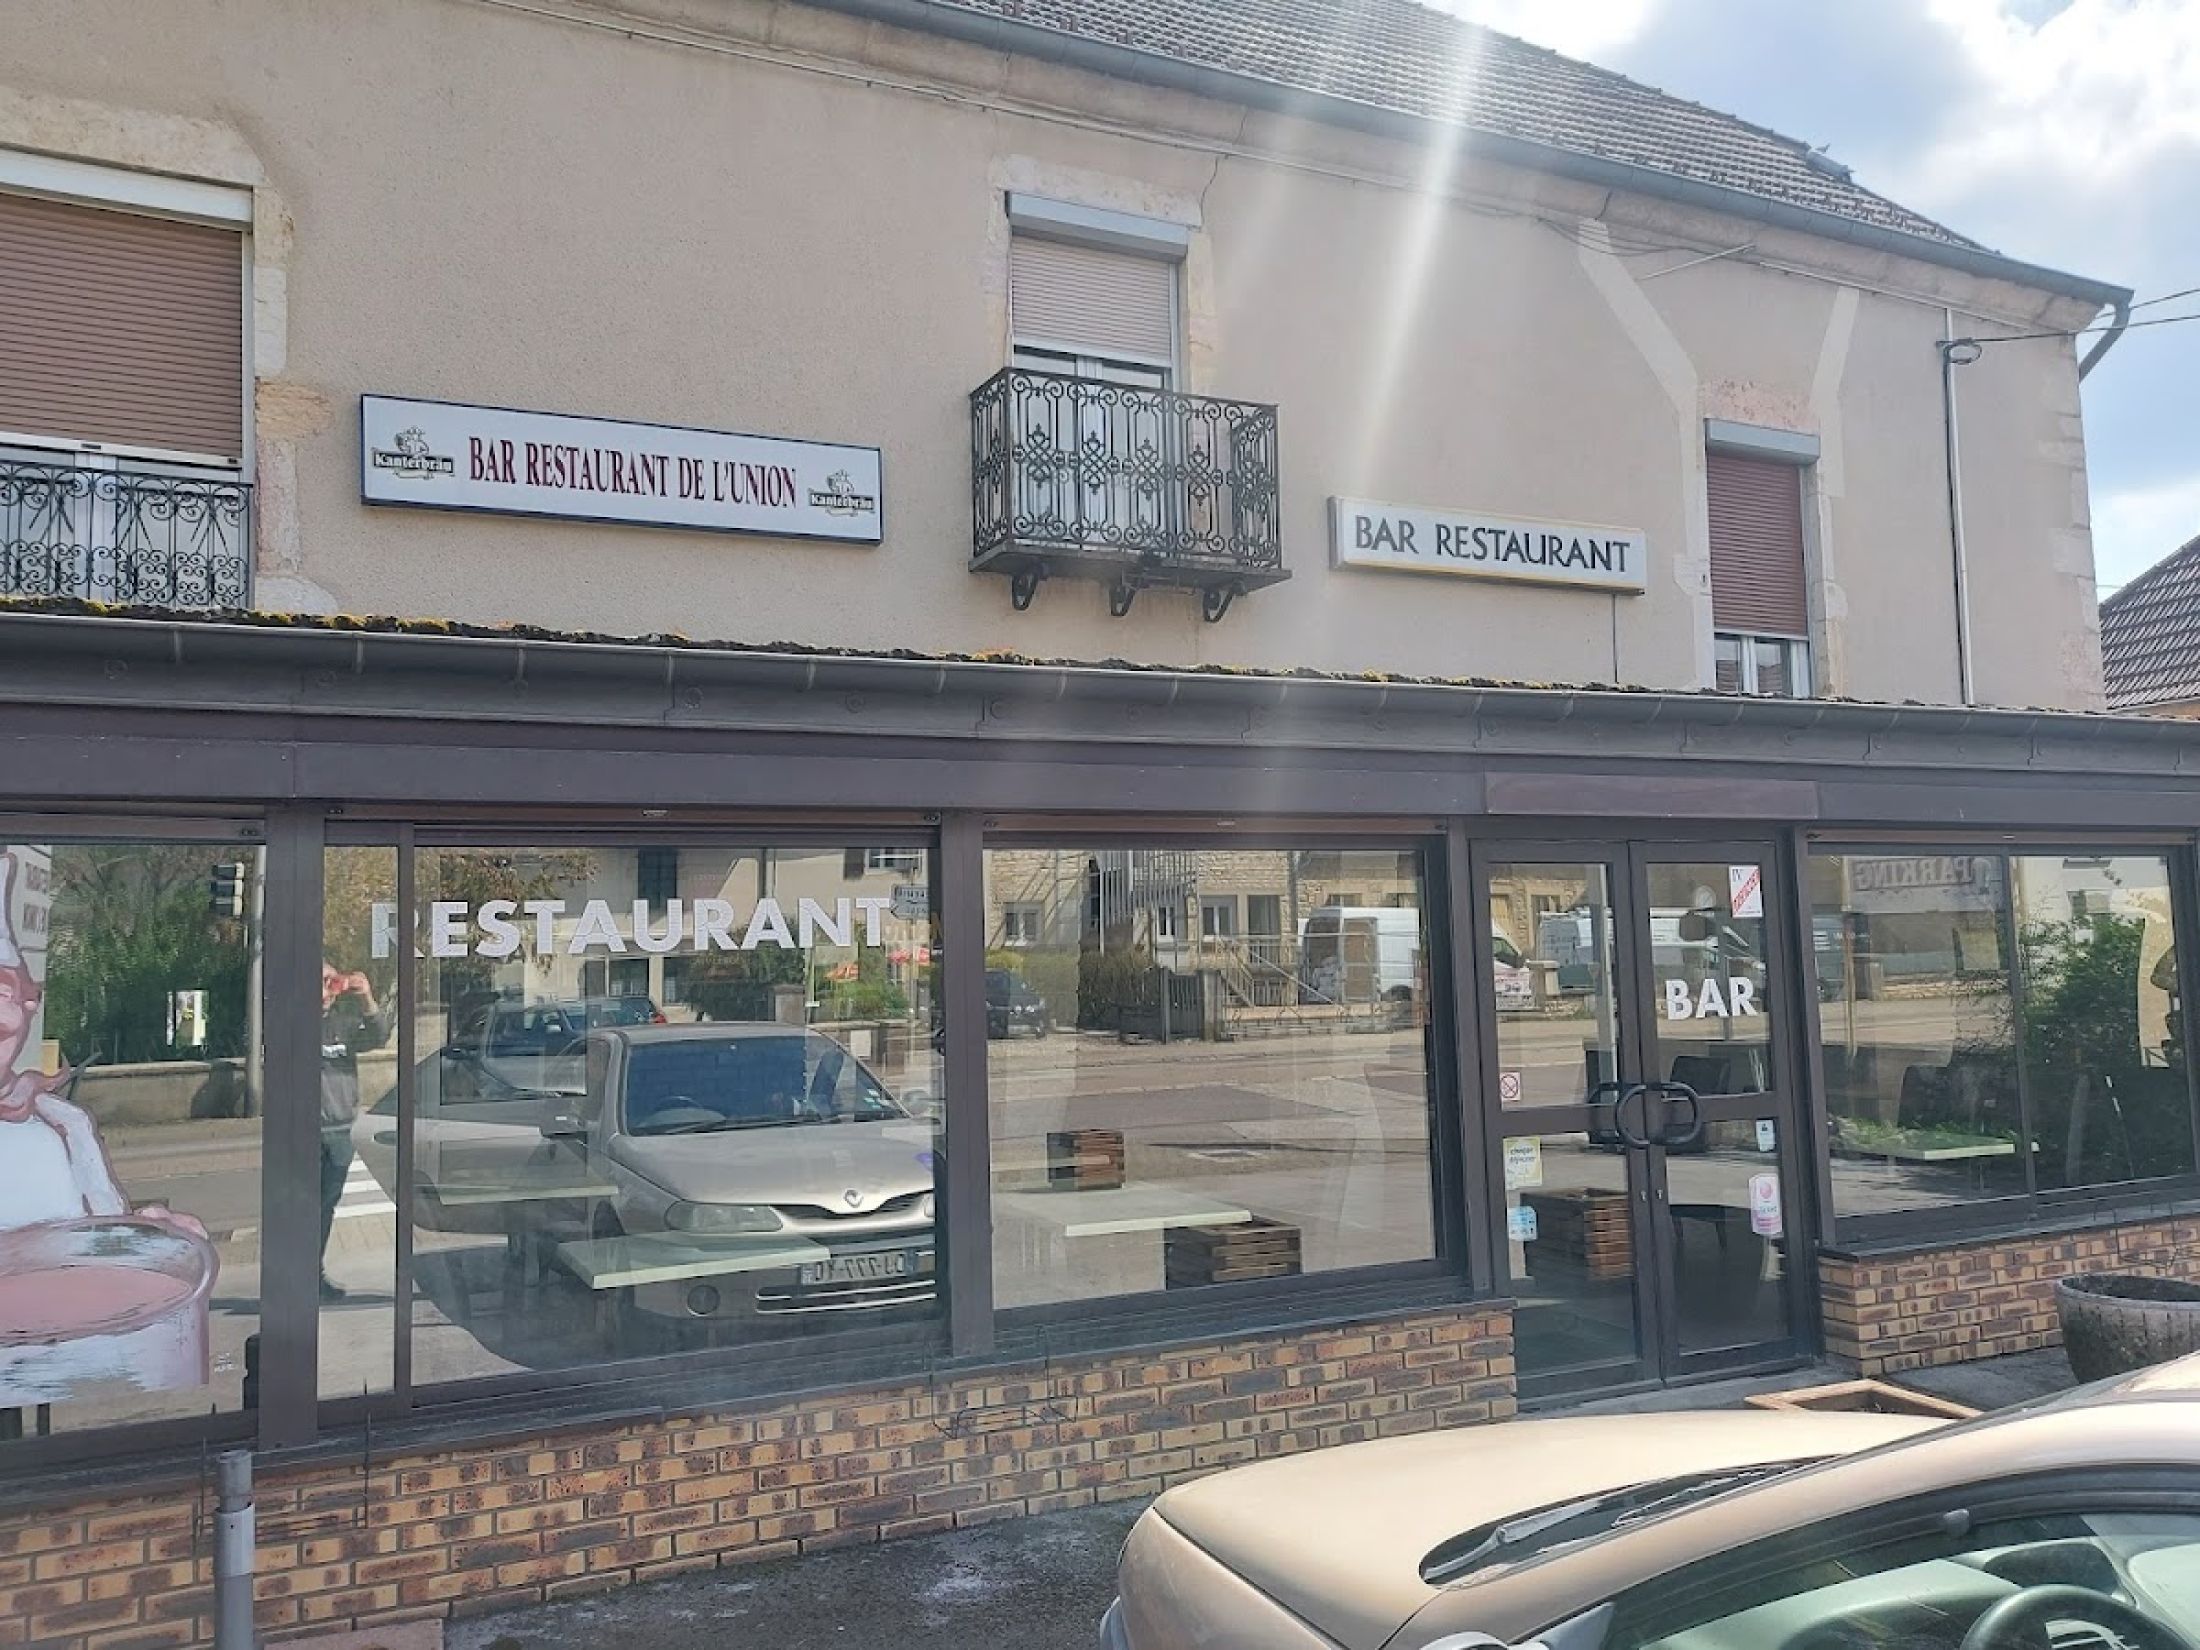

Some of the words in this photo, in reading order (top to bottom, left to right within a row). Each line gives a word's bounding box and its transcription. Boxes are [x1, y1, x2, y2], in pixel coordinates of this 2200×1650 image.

[468, 437, 516, 485] BAR
[526, 442, 668, 497] RESTAURANT
[679, 457, 705, 500] DE
[713, 460, 796, 508] L'UNION
[1355, 515, 1419, 554] BAR
[1436, 524, 1631, 572] RESTAURANT
[371, 897, 891, 959] RESTAURANT
[1665, 977, 1758, 1019] BAR
